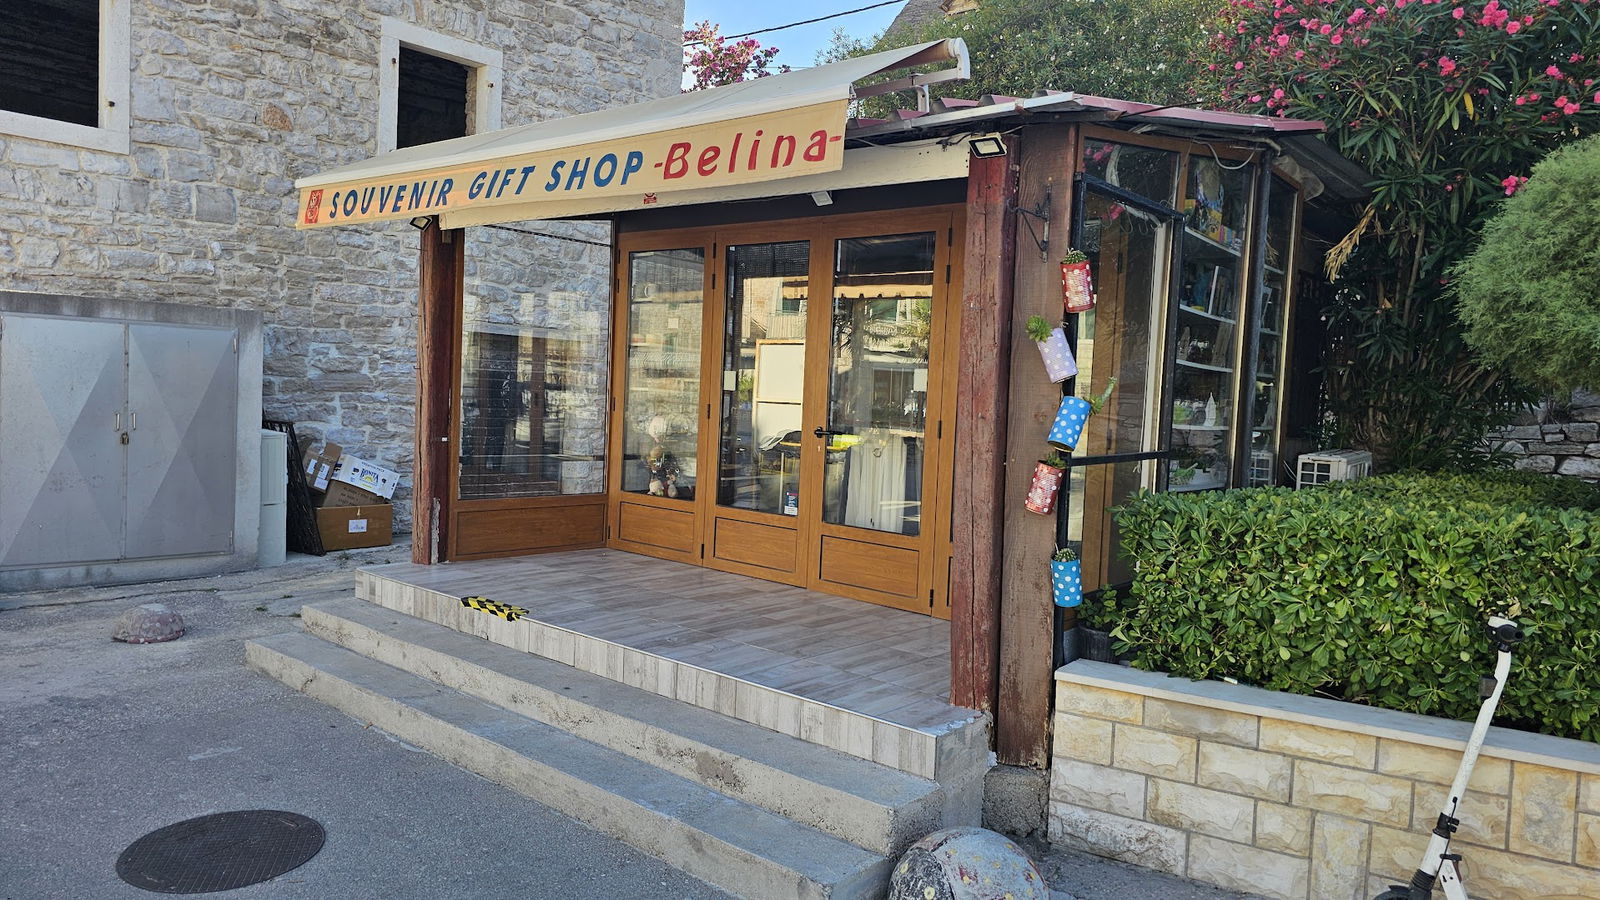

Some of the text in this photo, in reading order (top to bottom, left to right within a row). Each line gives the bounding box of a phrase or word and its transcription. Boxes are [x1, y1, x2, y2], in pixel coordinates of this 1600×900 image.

[329, 178, 454, 219] SOUVENIR
[468, 165, 556, 200] GIFT
[545, 151, 644, 192] SHOP
